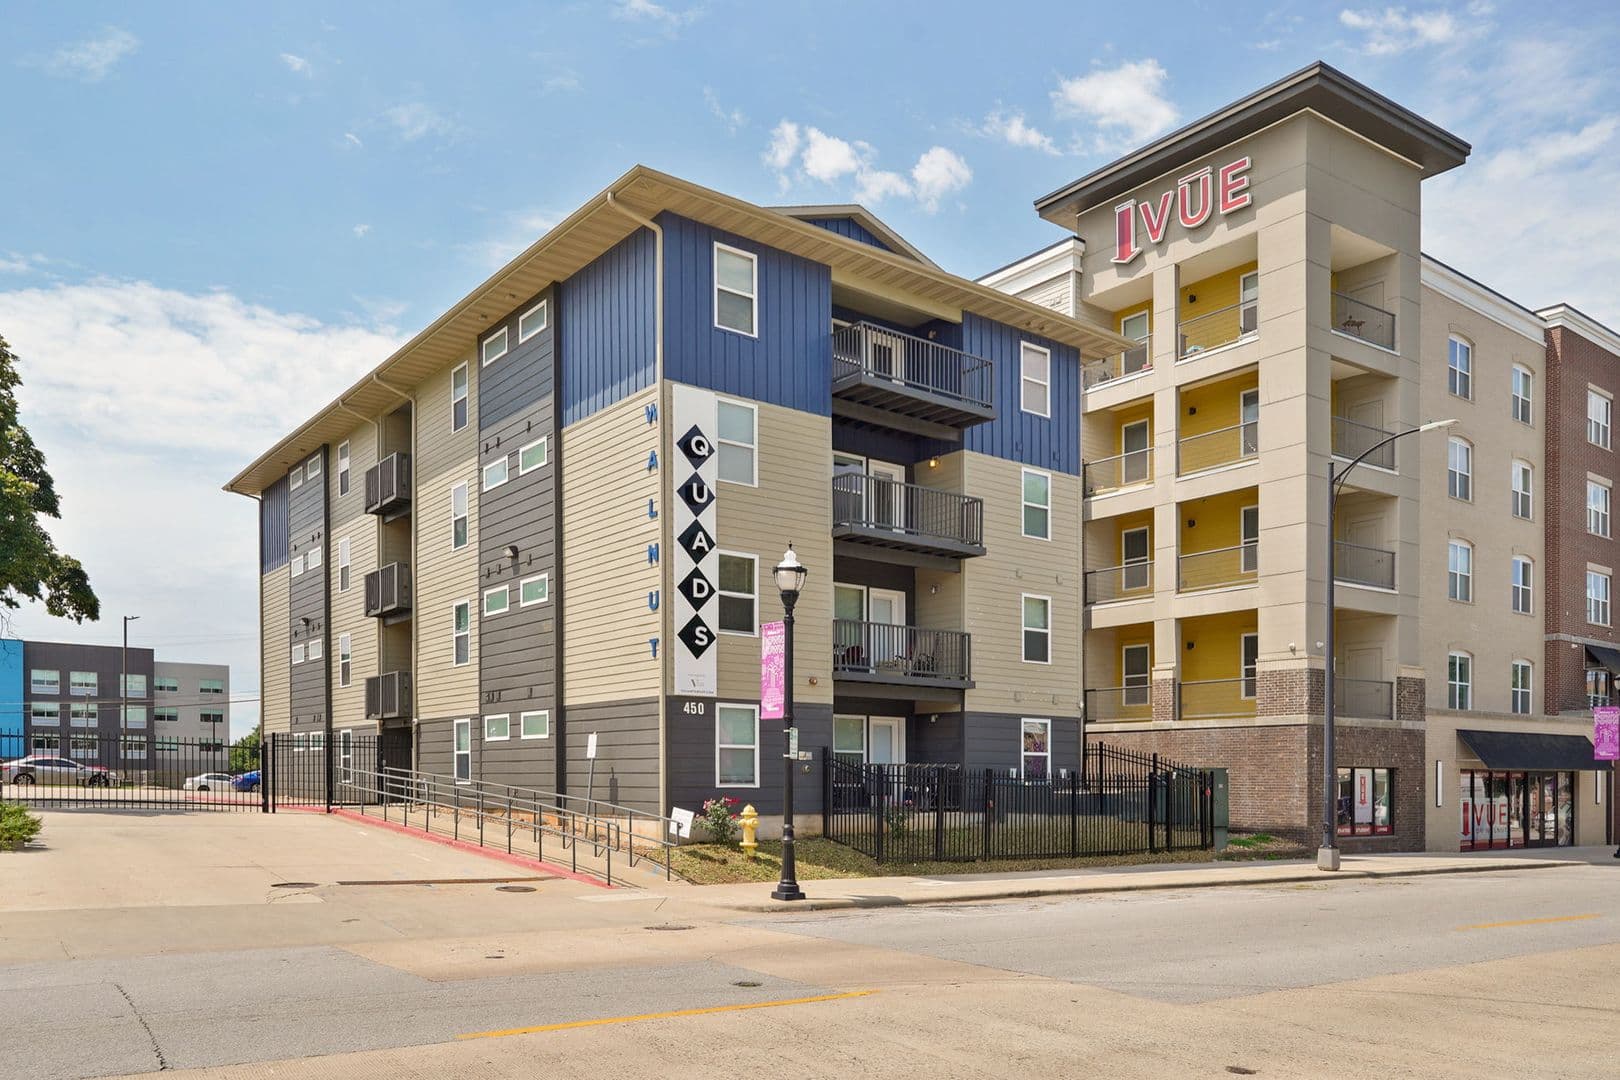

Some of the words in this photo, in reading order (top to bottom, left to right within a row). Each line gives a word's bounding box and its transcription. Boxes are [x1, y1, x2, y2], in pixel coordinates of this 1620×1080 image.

[645, 403, 660, 658] WALNUT
[690, 435, 709, 646] QUADS
[683, 701, 705, 715] 450
